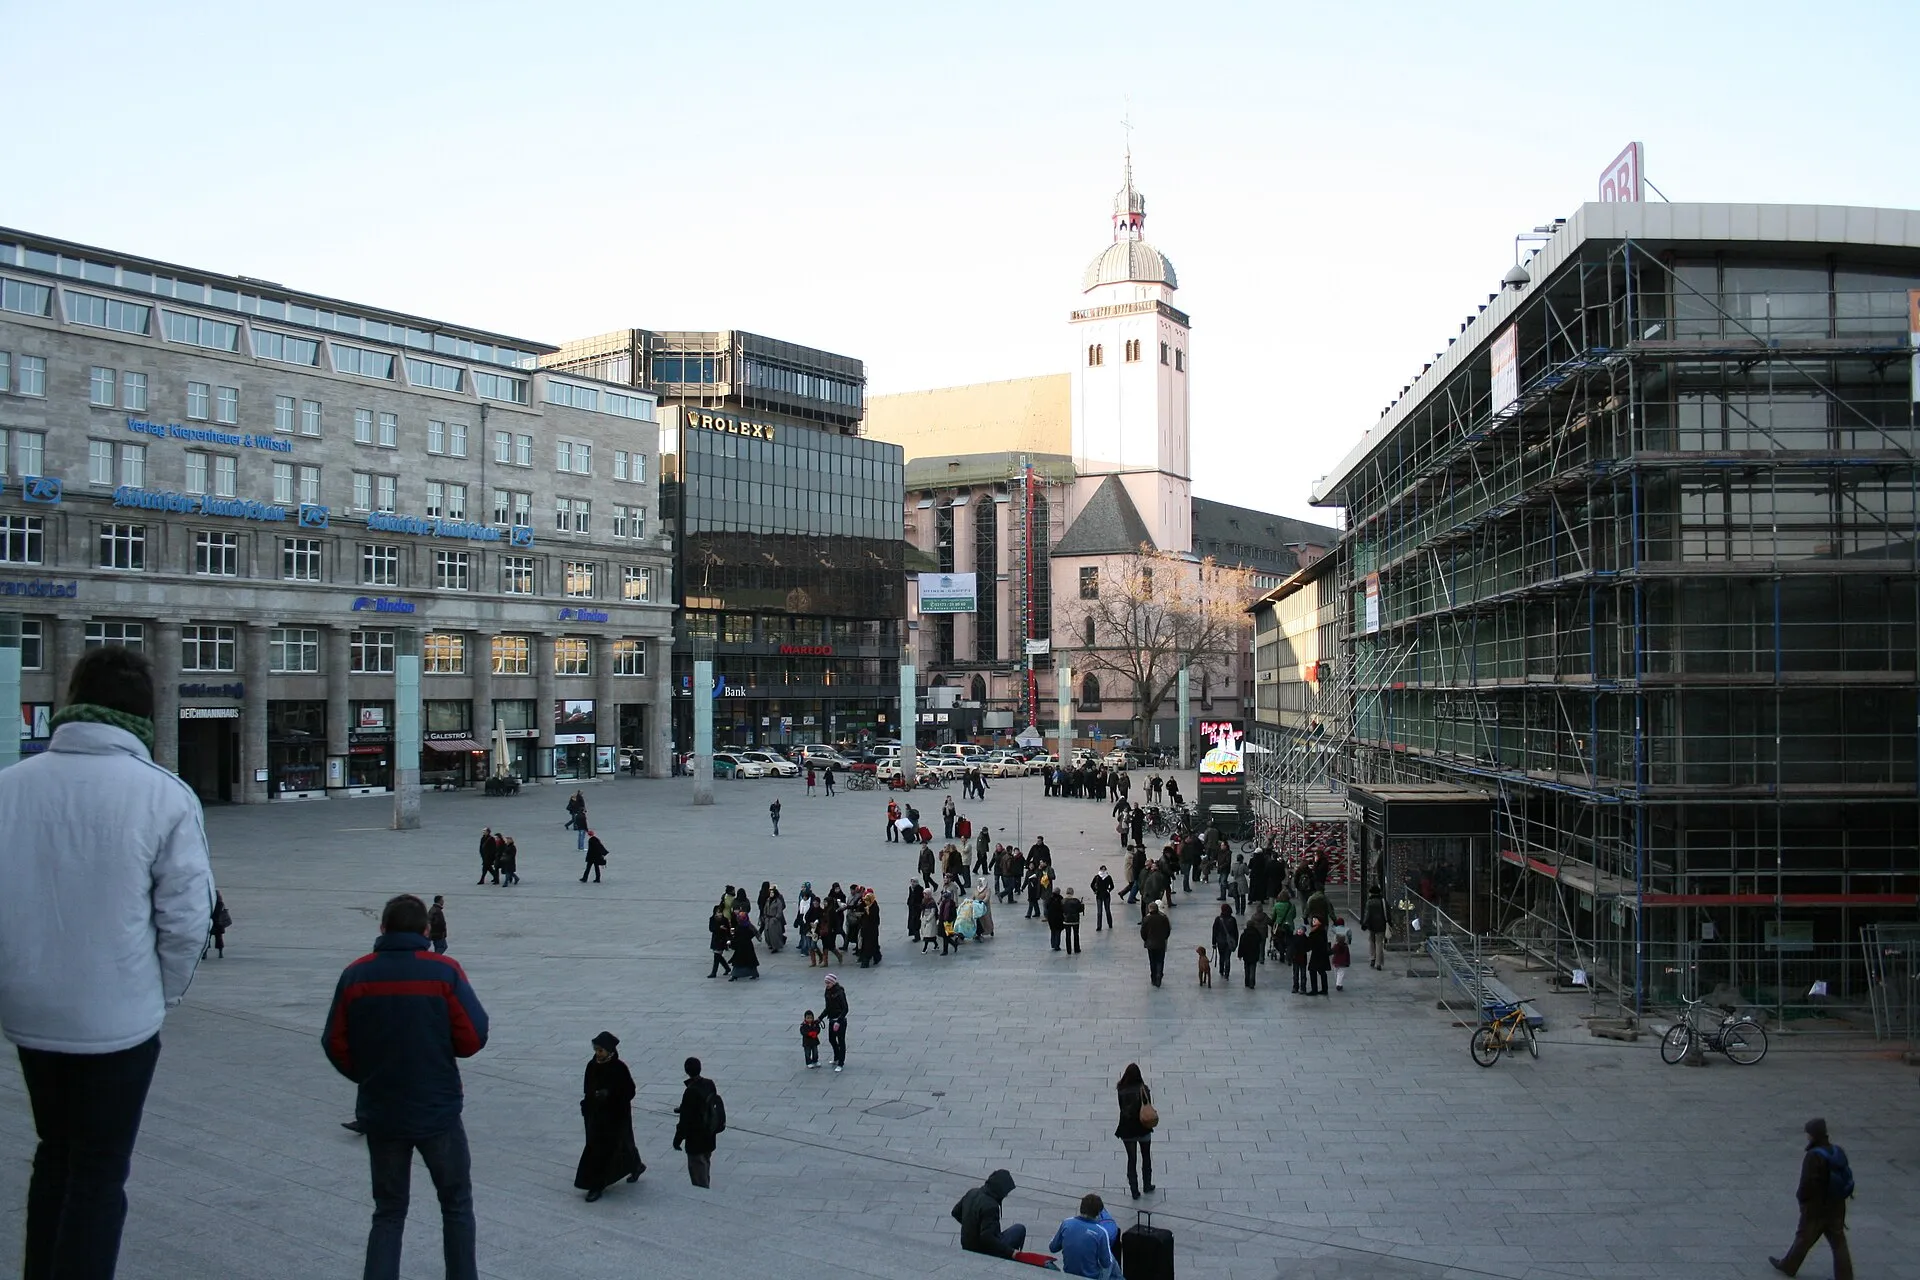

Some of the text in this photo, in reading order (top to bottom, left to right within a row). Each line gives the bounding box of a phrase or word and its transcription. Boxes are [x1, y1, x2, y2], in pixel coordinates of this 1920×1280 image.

[1603, 162, 1630, 203] DB
[702, 415, 763, 438] ROLEX
[127, 417, 293, 453] Verlag Kiepenheuer & Witsch
[780, 645, 832, 655] MAREDO
[725, 686, 746, 697] Bank
[180, 708, 239, 719] DEICHMANNHAUS
[430, 732, 466, 740] GALESTRO
